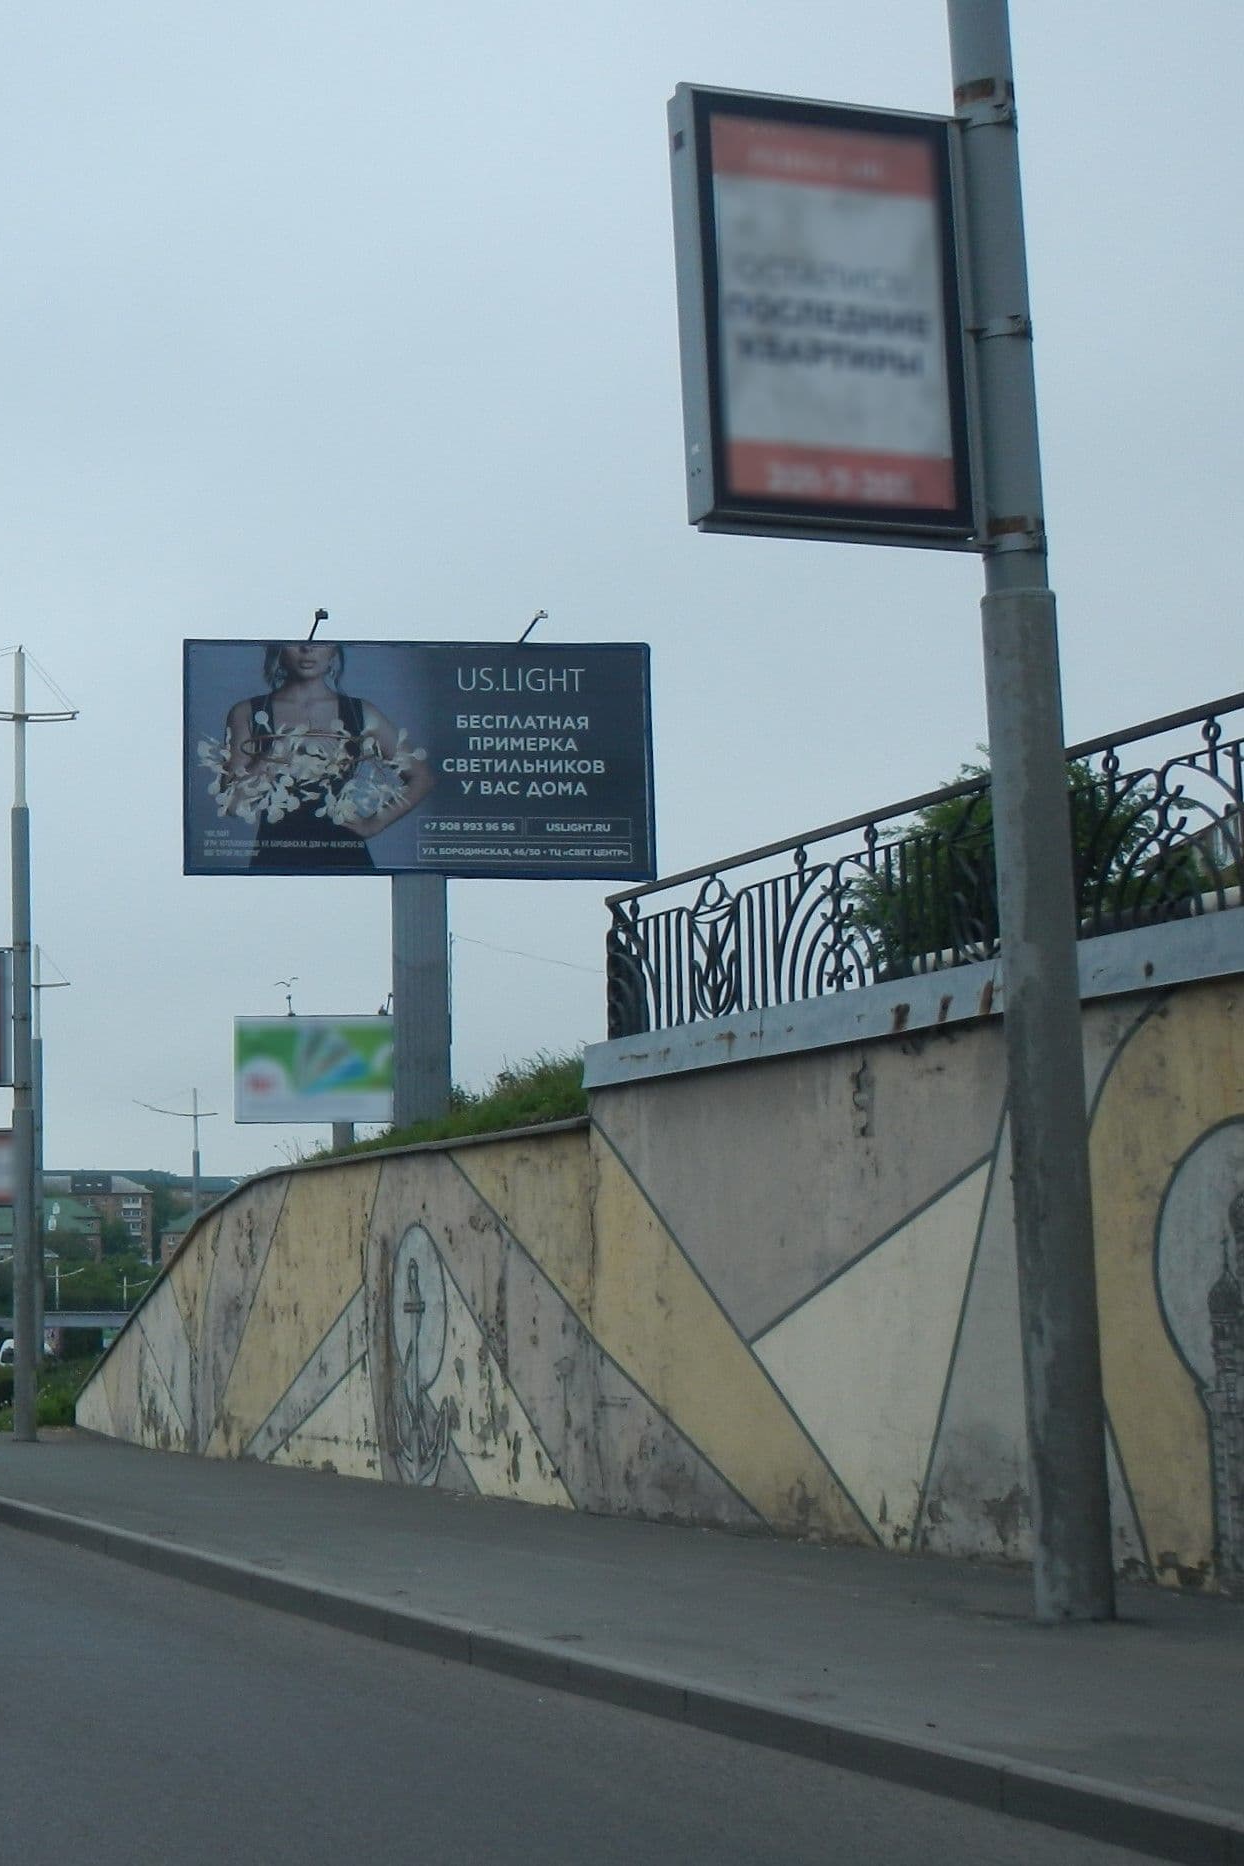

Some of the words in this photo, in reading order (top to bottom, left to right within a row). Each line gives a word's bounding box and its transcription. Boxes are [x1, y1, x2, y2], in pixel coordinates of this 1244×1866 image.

[457, 667, 586, 692] US.LIGHT
[456, 714, 589, 730] БЕСПЛАТНАЯ
[468, 736, 578, 751] ПРИМЕРКА
[442, 758, 605, 774] СВЕТИЛЬНИКОВ
[460, 780, 474, 795] У
[480, 781, 520, 795] ВАС
[526, 781, 588, 797] ДОМА
[501, 823, 516, 832] 96
[545, 823, 611, 833] USLIGHT.RU
